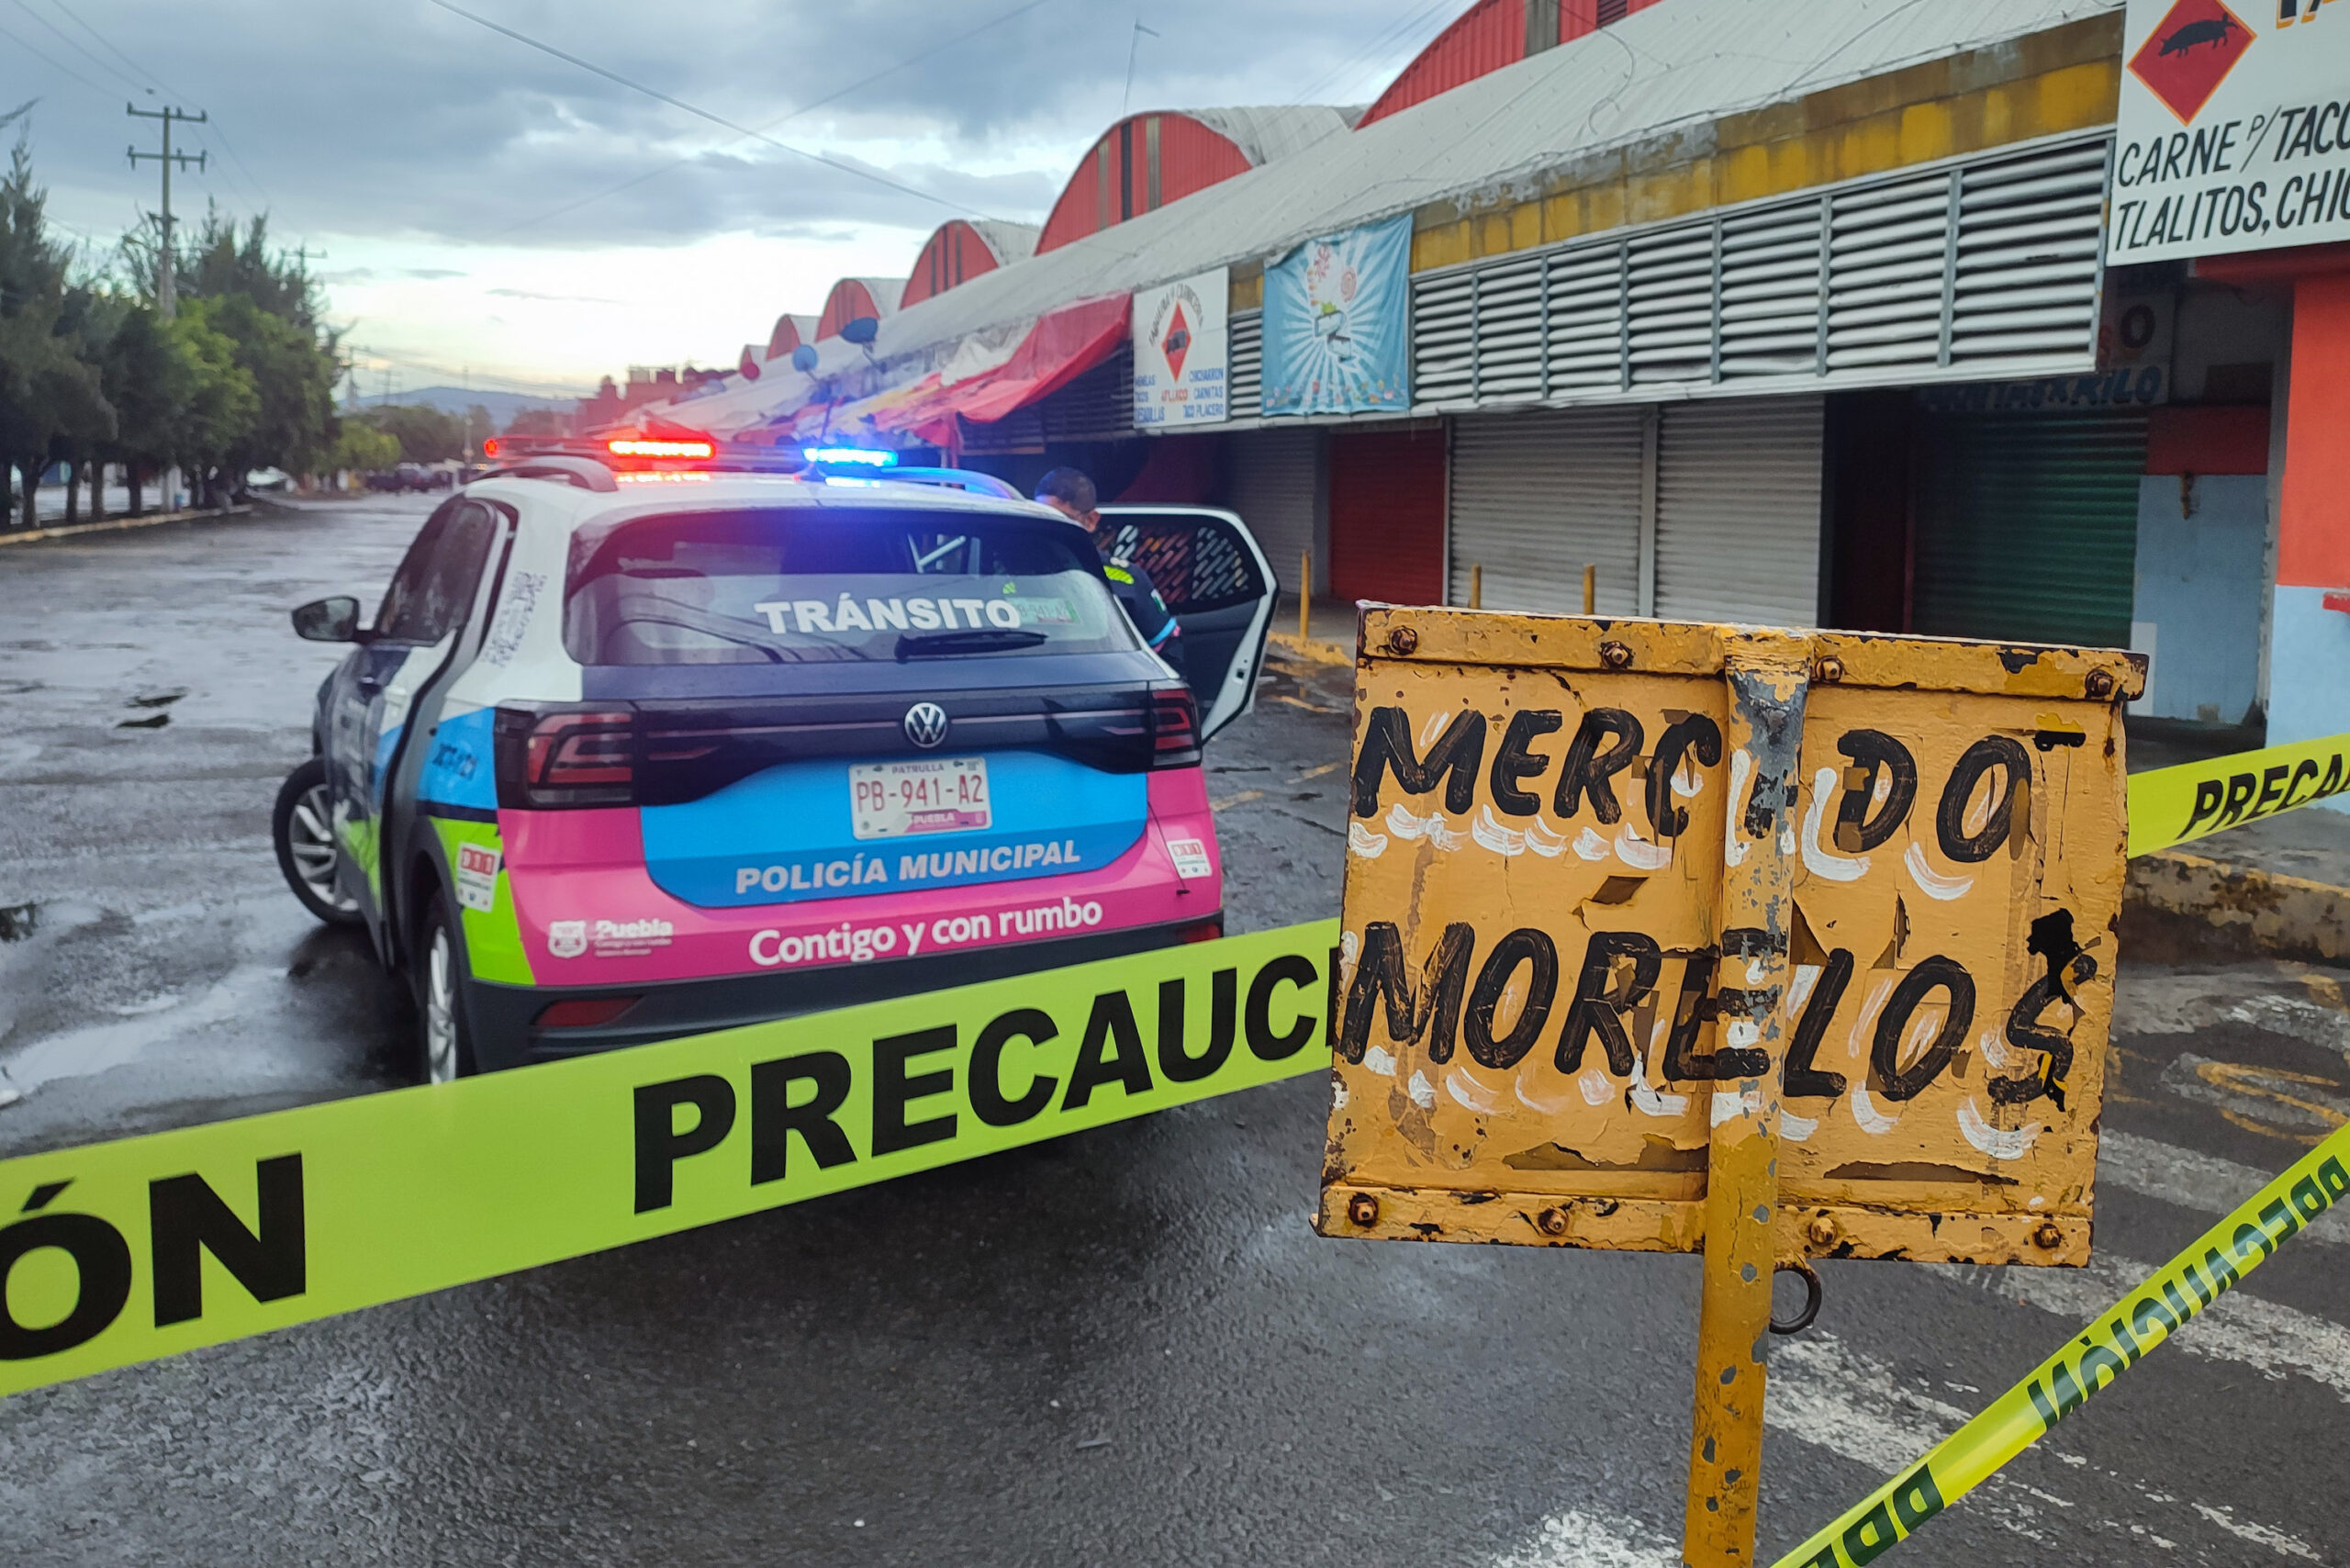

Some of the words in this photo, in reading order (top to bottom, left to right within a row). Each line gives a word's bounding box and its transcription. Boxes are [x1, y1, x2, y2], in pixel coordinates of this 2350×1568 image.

[2119, 120, 2242, 187] CARNE
[755, 593, 1023, 634] TRÁNSITO
[891, 763, 945, 774] PATRULLA
[856, 774, 984, 813] PB-941-A2
[2175, 754, 2350, 841] PRECA
[912, 812, 956, 824] PUEBLA
[736, 853, 888, 894] POLICÍA
[900, 840, 1081, 880] MUNICIPAL
[595, 917, 674, 939] Puebla
[748, 921, 897, 966] Contigo
[900, 921, 926, 956] y
[932, 914, 991, 944] con
[1000, 896, 1102, 935] rumbo
[1335, 919, 2098, 1103] MORELOS
